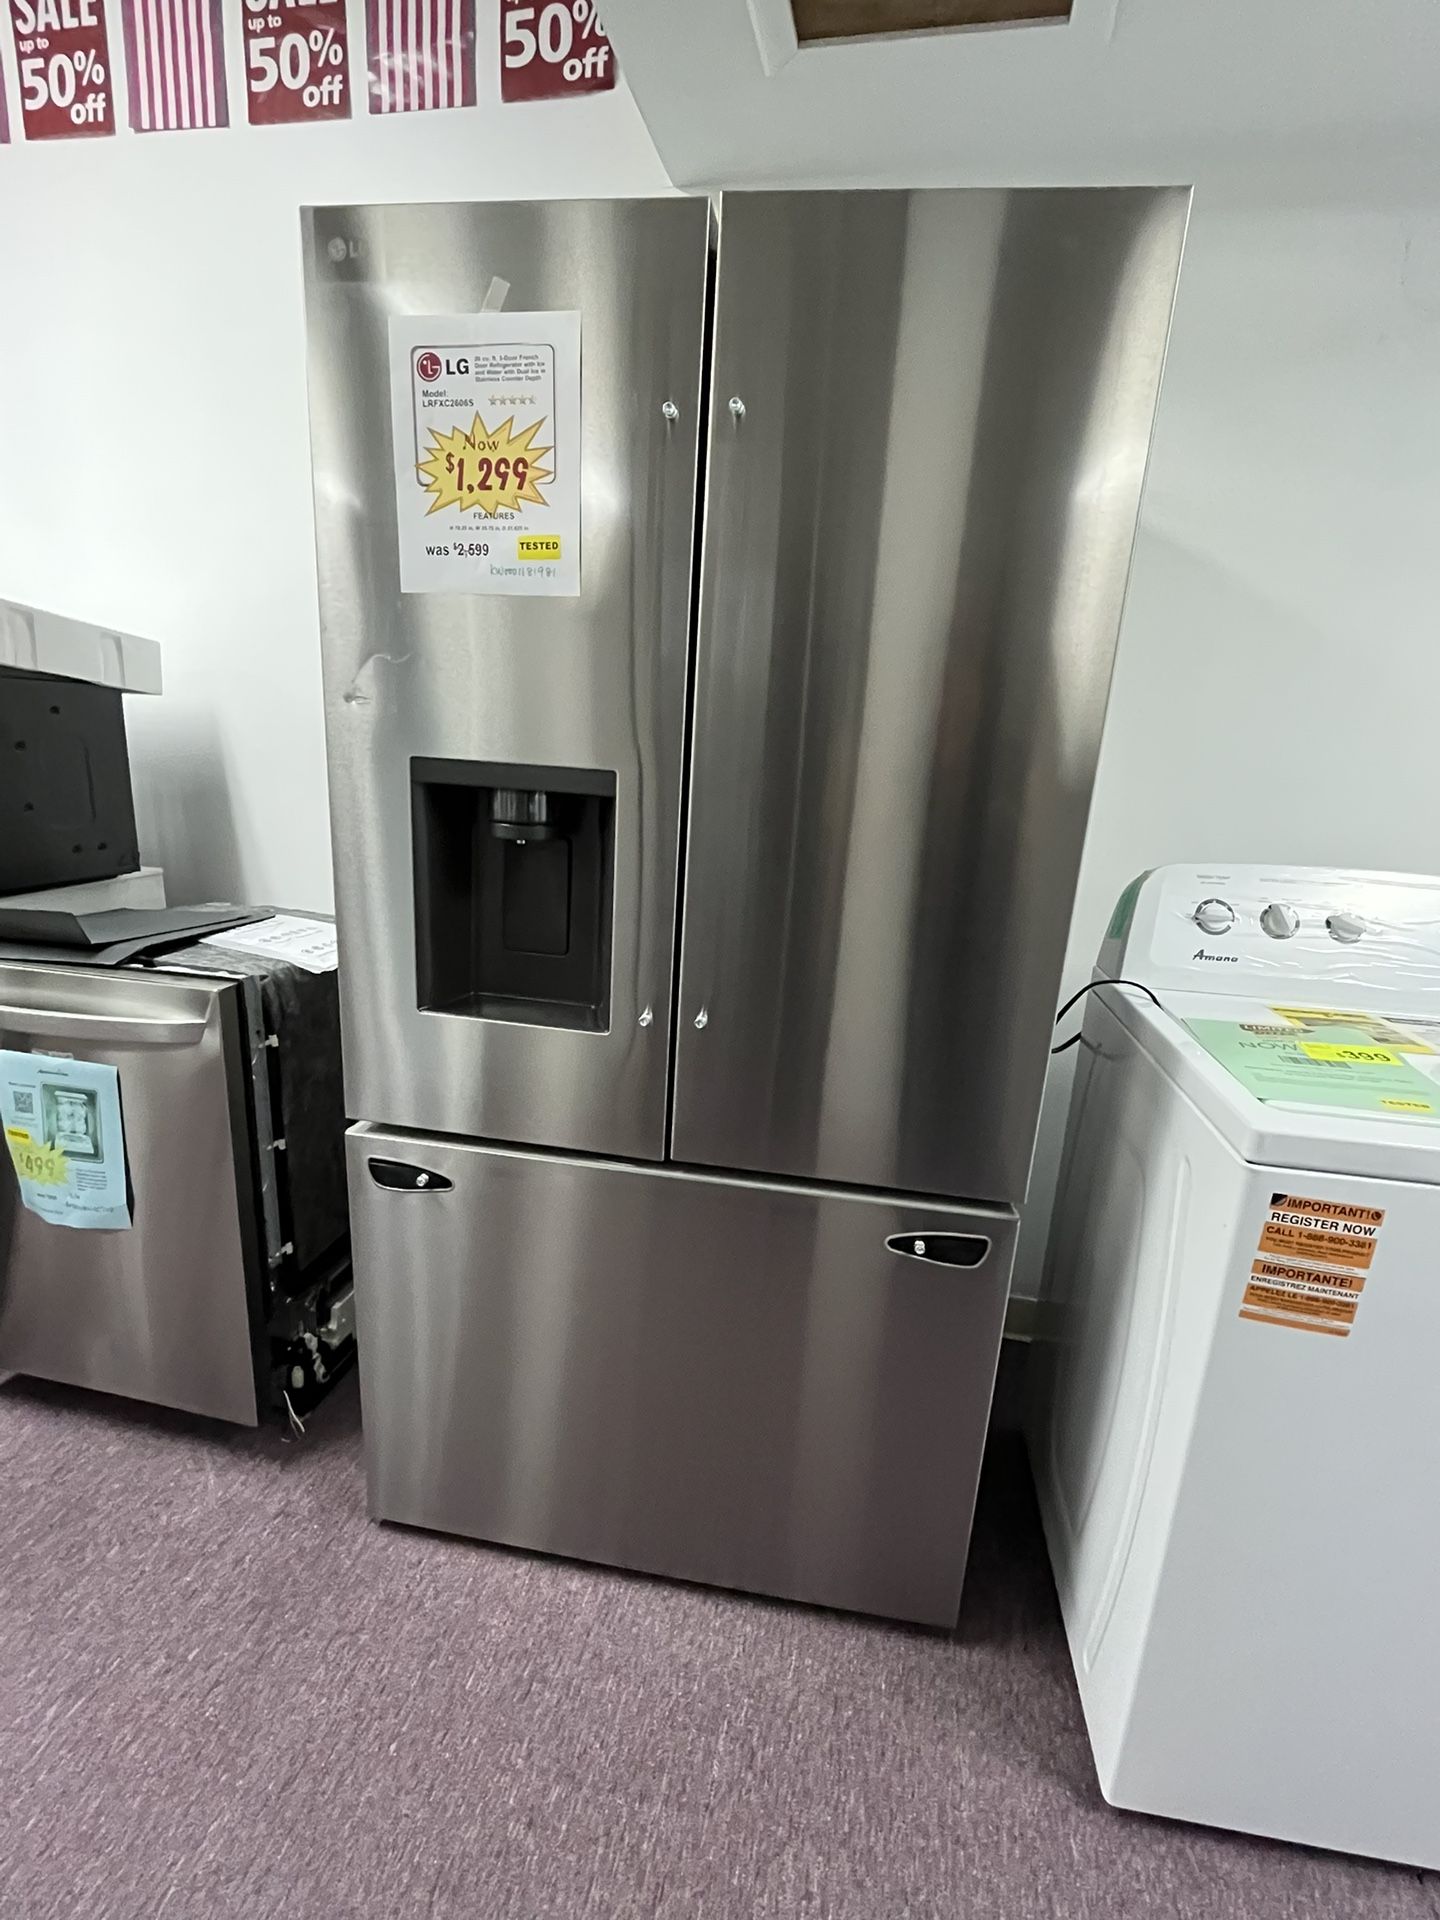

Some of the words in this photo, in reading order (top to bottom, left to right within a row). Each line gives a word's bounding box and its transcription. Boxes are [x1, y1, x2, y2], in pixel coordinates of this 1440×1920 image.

[248, 17, 265, 33] up
[267, 14, 282, 28] to
[505, 0, 606, 68] 50%
[19, 39, 35, 54] up
[36, 37, 49, 50] to
[249, 27, 344, 93] 50%
[562, 45, 609, 82] off
[21, 48, 105, 111] 50%
[302, 74, 343, 108] off
[70, 92, 106, 125] off
[445, 357, 470, 376] LG
[445, 451, 529, 494] $1,299
[473, 511, 516, 520] FEATURES
[425, 545, 450, 556] was
[519, 541, 559, 551] TESTED
[1192, 948, 1240, 964] Amana
[1238, 1041, 1298, 1051] NOW
[1287, 1198, 1371, 1220] IMPORTANT!
[1266, 1225, 1295, 1238] CALL
[1271, 1211, 1339, 1231] REGISTER
[1342, 1222, 1376, 1237] NOW
[1250, 1274, 1307, 1292] ENREGISTREZ
[1307, 1285, 1360, 1300] MAINTENANT
[1261, 1263, 1353, 1289] IMPORTANTE!
